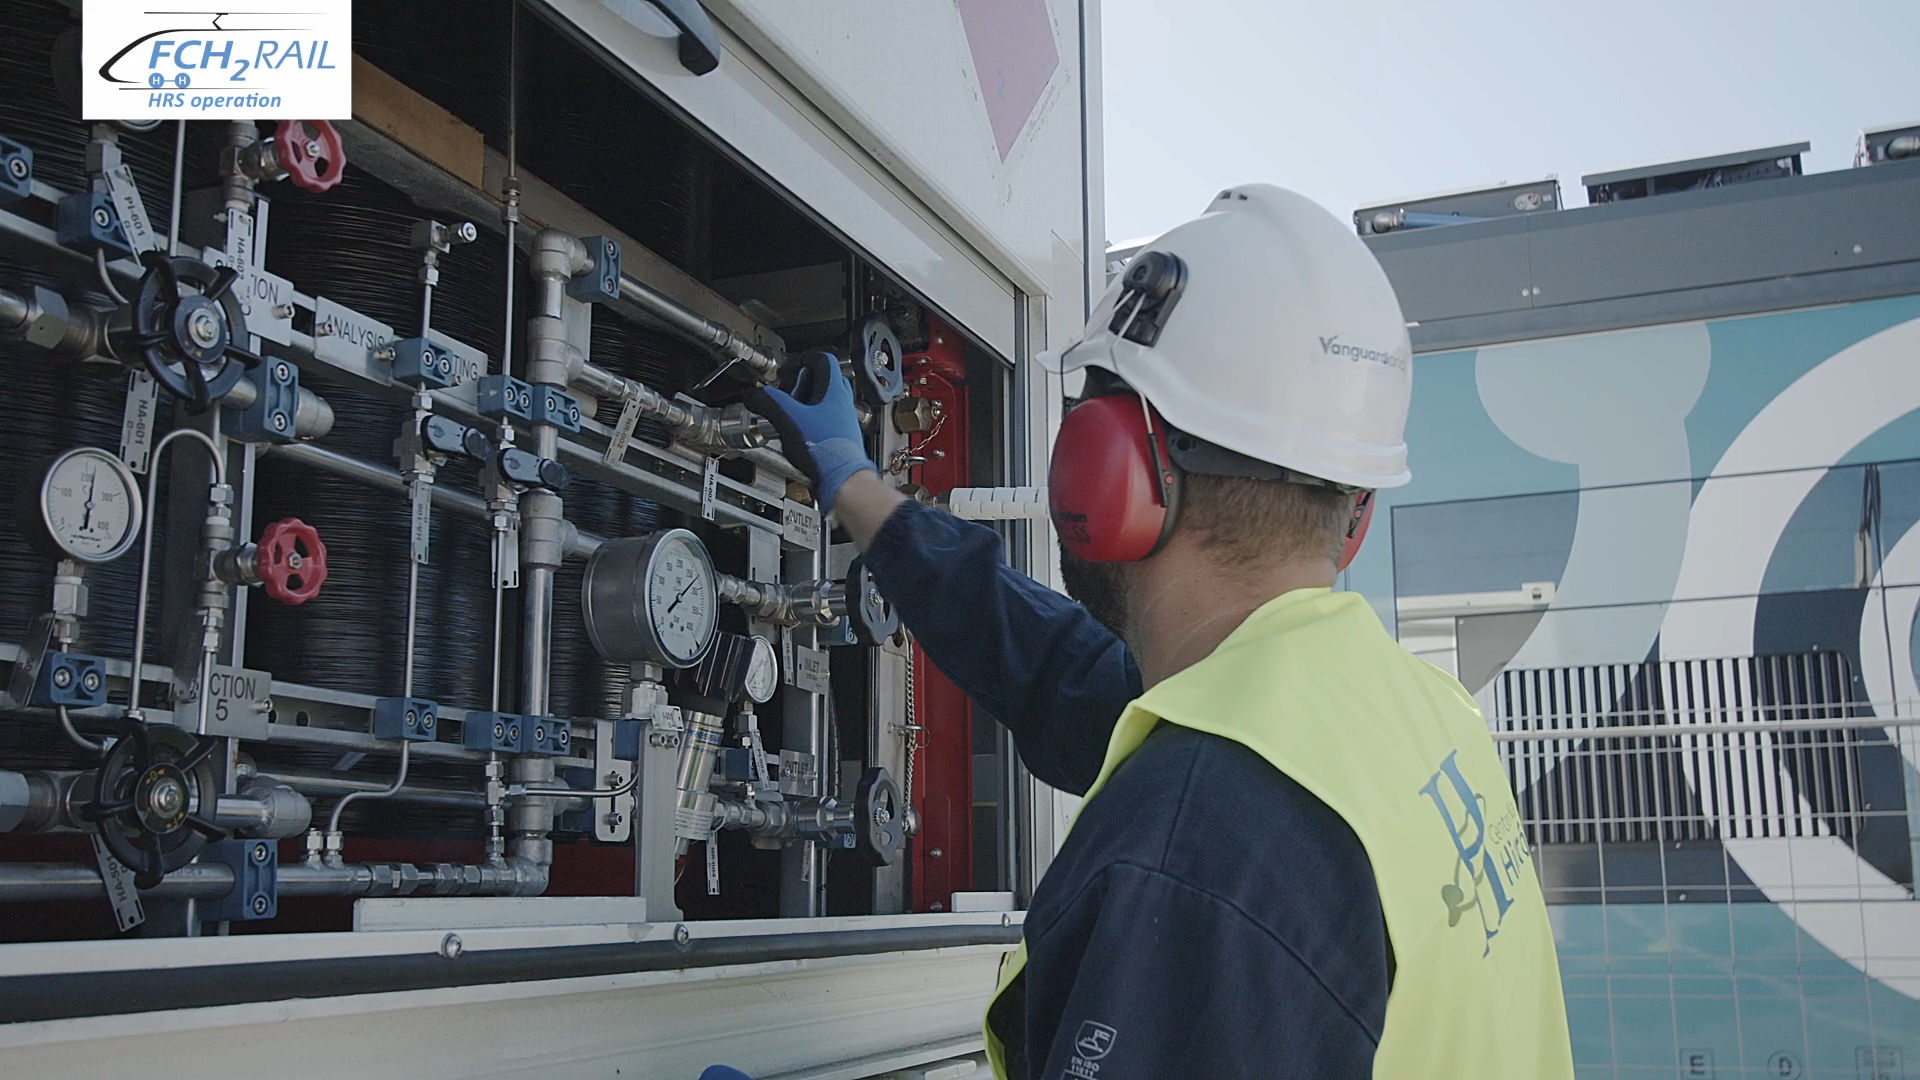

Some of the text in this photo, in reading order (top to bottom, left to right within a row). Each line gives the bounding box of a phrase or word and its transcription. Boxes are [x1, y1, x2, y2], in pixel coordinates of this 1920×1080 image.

[124, 196, 146, 236] PI-601
[135, 399, 149, 445] HA-601
[215, 699, 229, 722] 5
[1689, 1054, 1706, 1076] E
[1778, 1056, 1793, 1077] D
